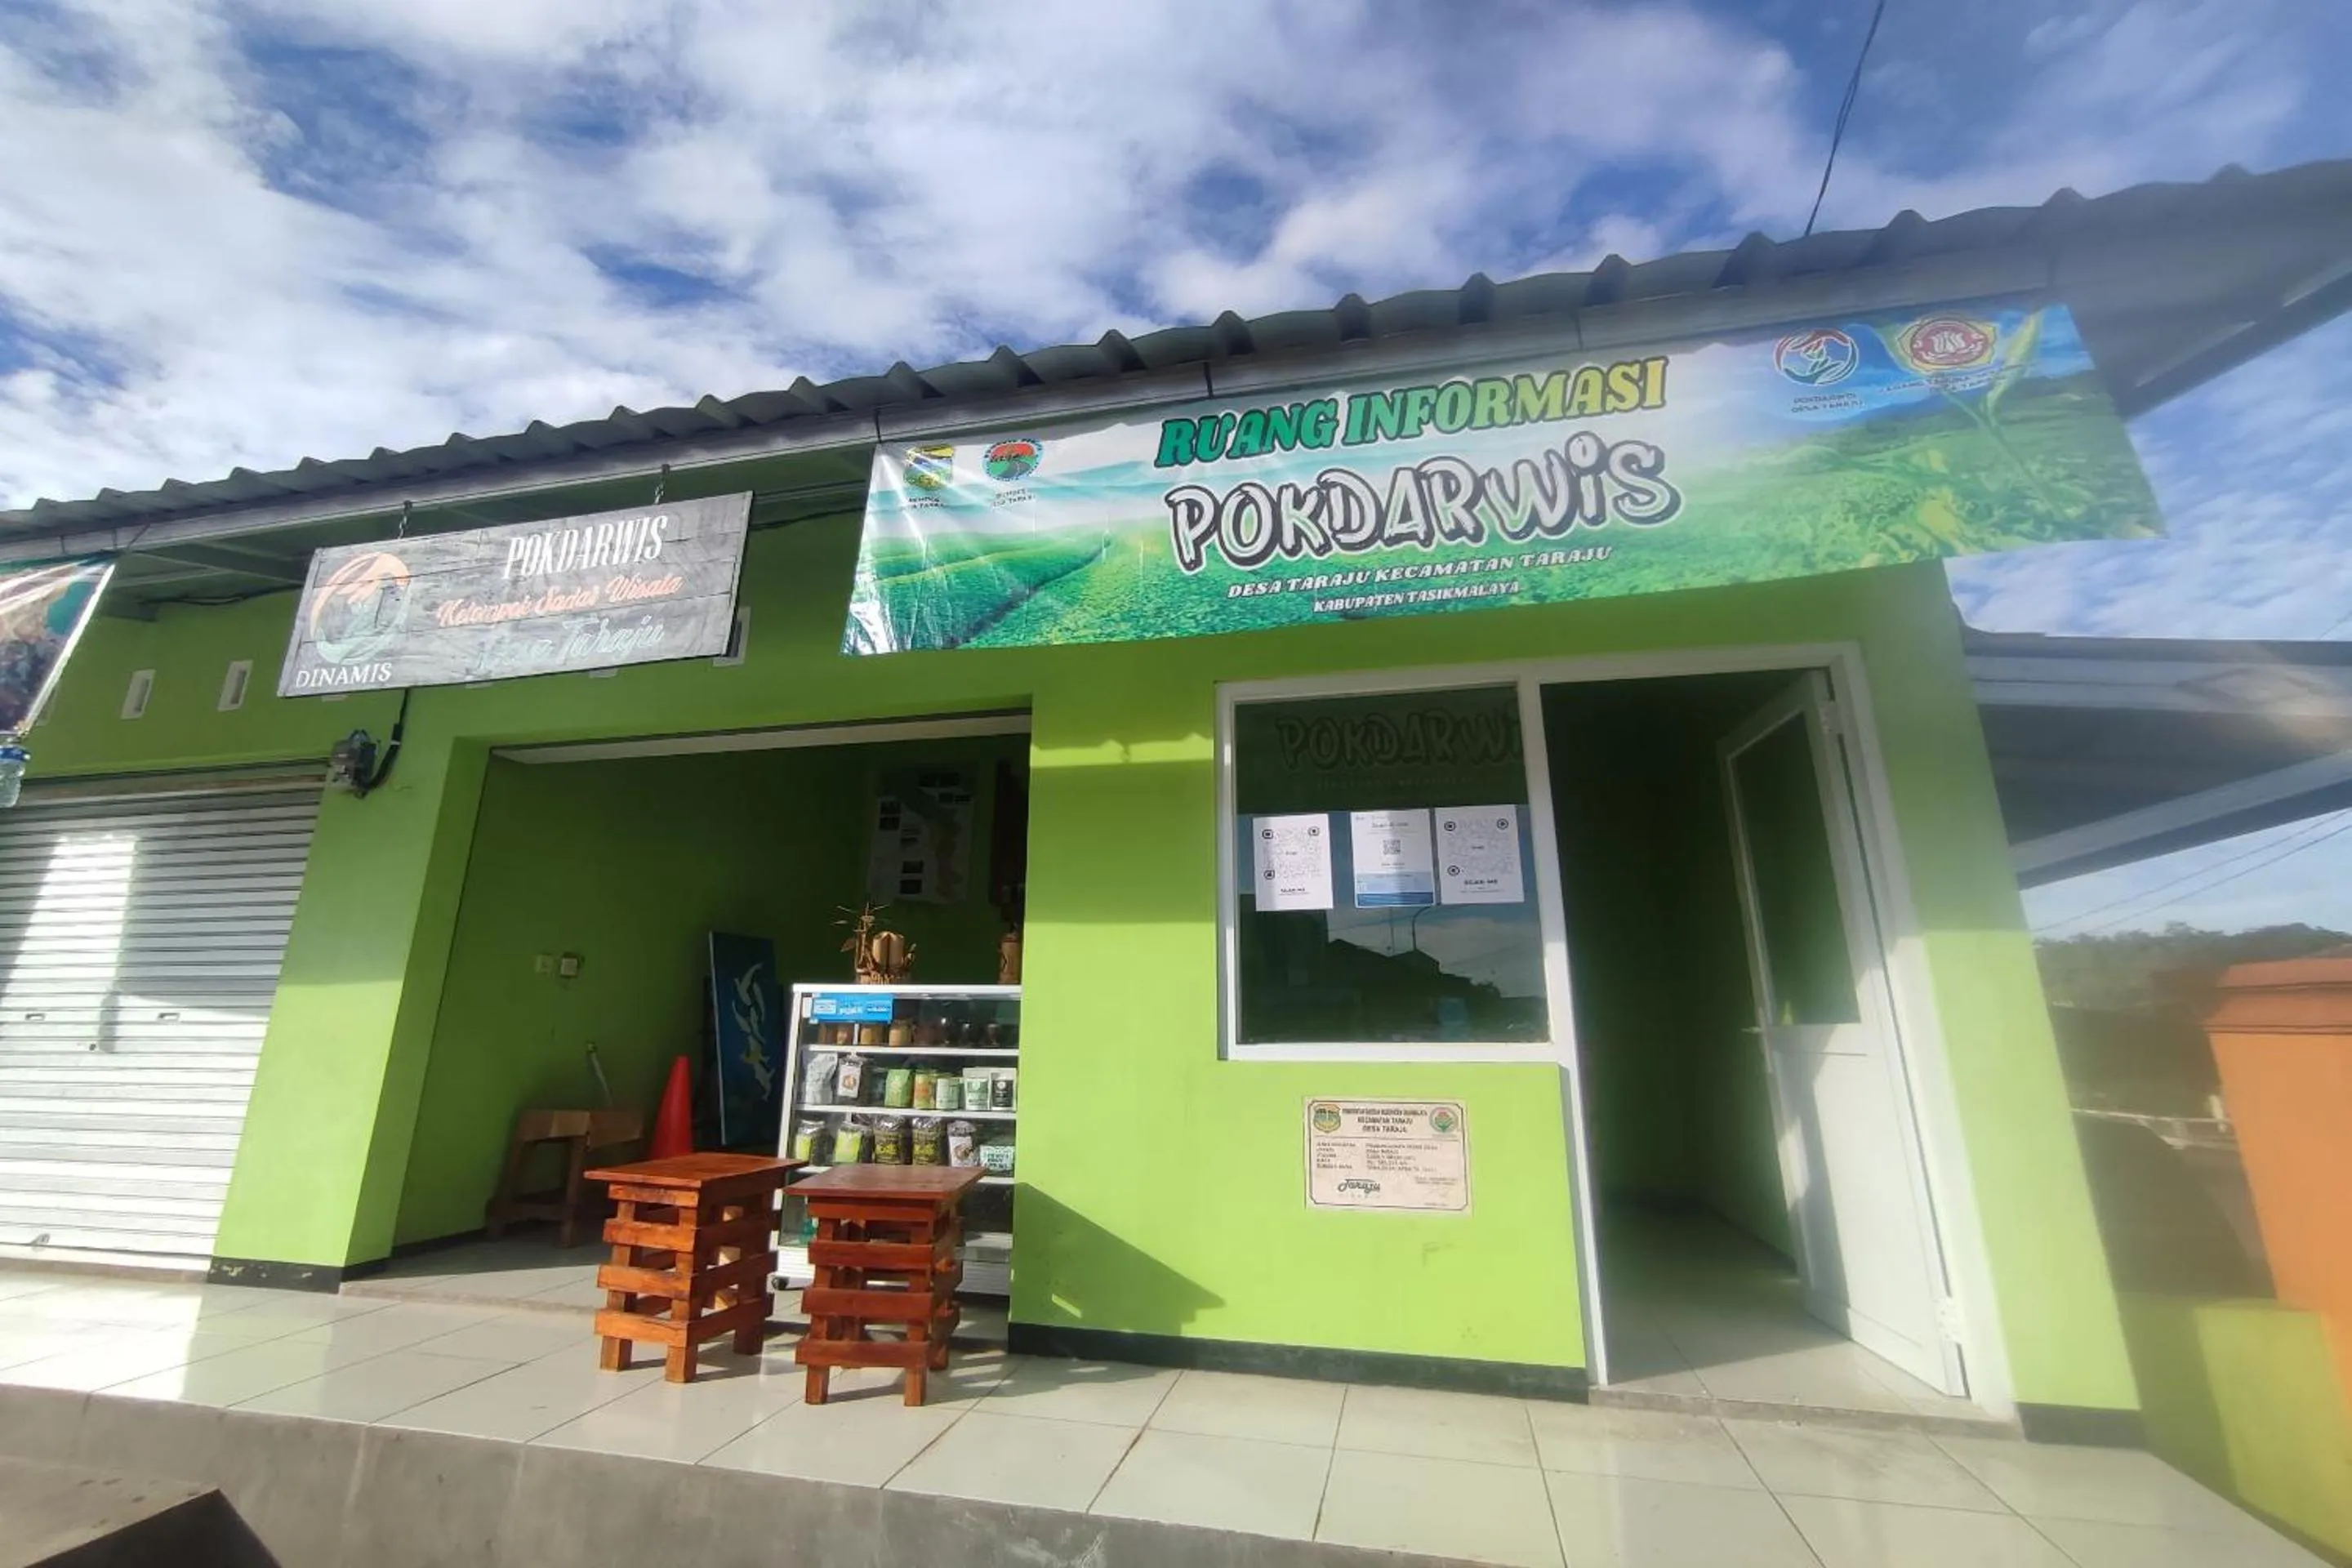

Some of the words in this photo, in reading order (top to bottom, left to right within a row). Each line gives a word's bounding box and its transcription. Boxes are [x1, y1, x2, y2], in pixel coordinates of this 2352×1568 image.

[1154, 396, 1340, 468] RUANG
[1342, 355, 1669, 446] INFORMASI
[501, 515, 668, 579] POKDARWIS
[1227, 581, 1284, 599] DESA
[1286, 570, 1372, 591] TARAJU
[1374, 555, 1514, 583] KECAMATAN
[1519, 546, 1613, 568] TARAJU
[1313, 591, 1405, 612] KABUPATEN
[1407, 581, 1520, 604] TASIKMALAYA
[296, 662, 394, 688] DINAMIS
